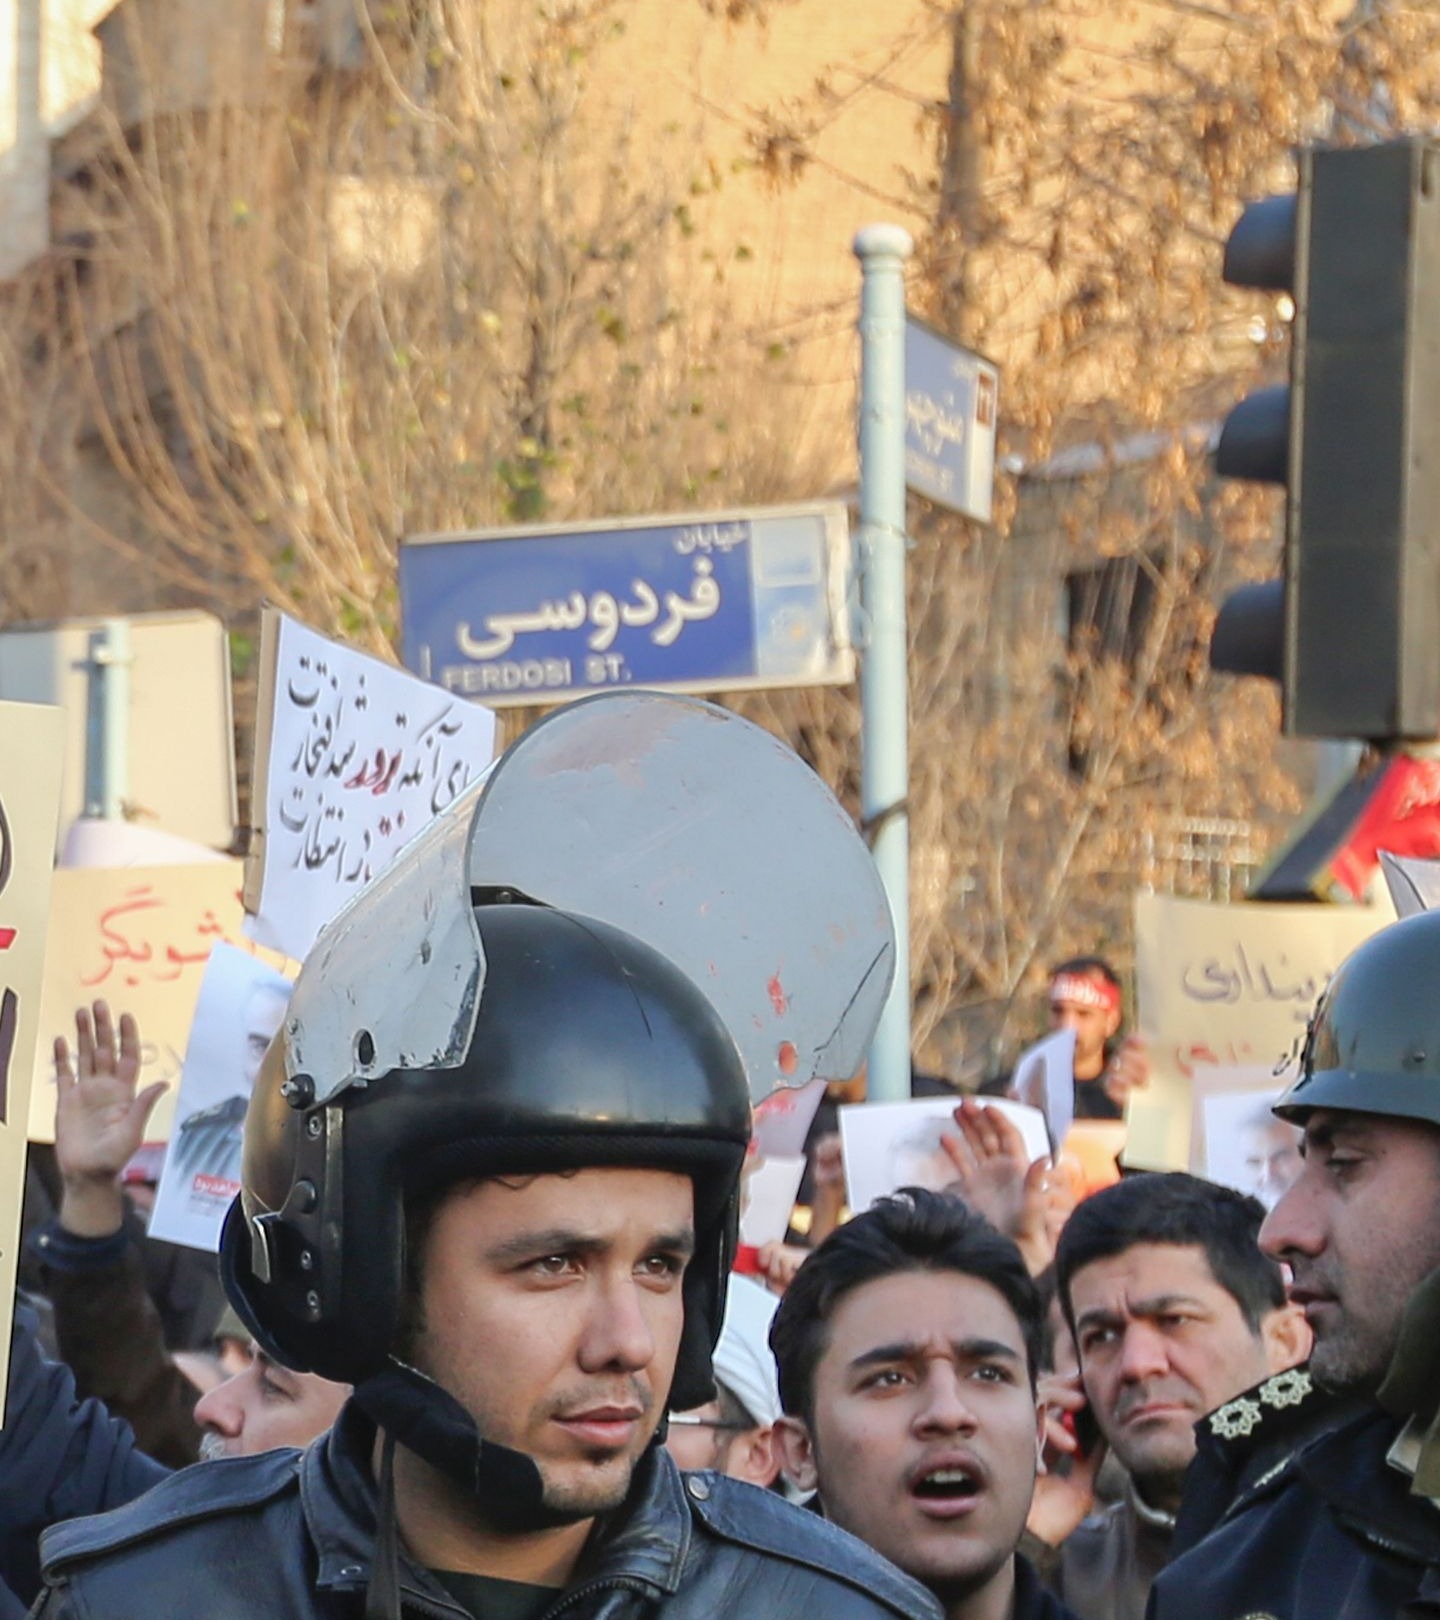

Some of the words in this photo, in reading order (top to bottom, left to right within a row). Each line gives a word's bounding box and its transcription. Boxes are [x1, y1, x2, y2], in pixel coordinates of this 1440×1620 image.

[674, 524, 749, 554] خیابان
[456, 555, 721, 661] فردوسی
[442, 659, 573, 693] FERDOSI
[584, 655, 633, 684] ST.
